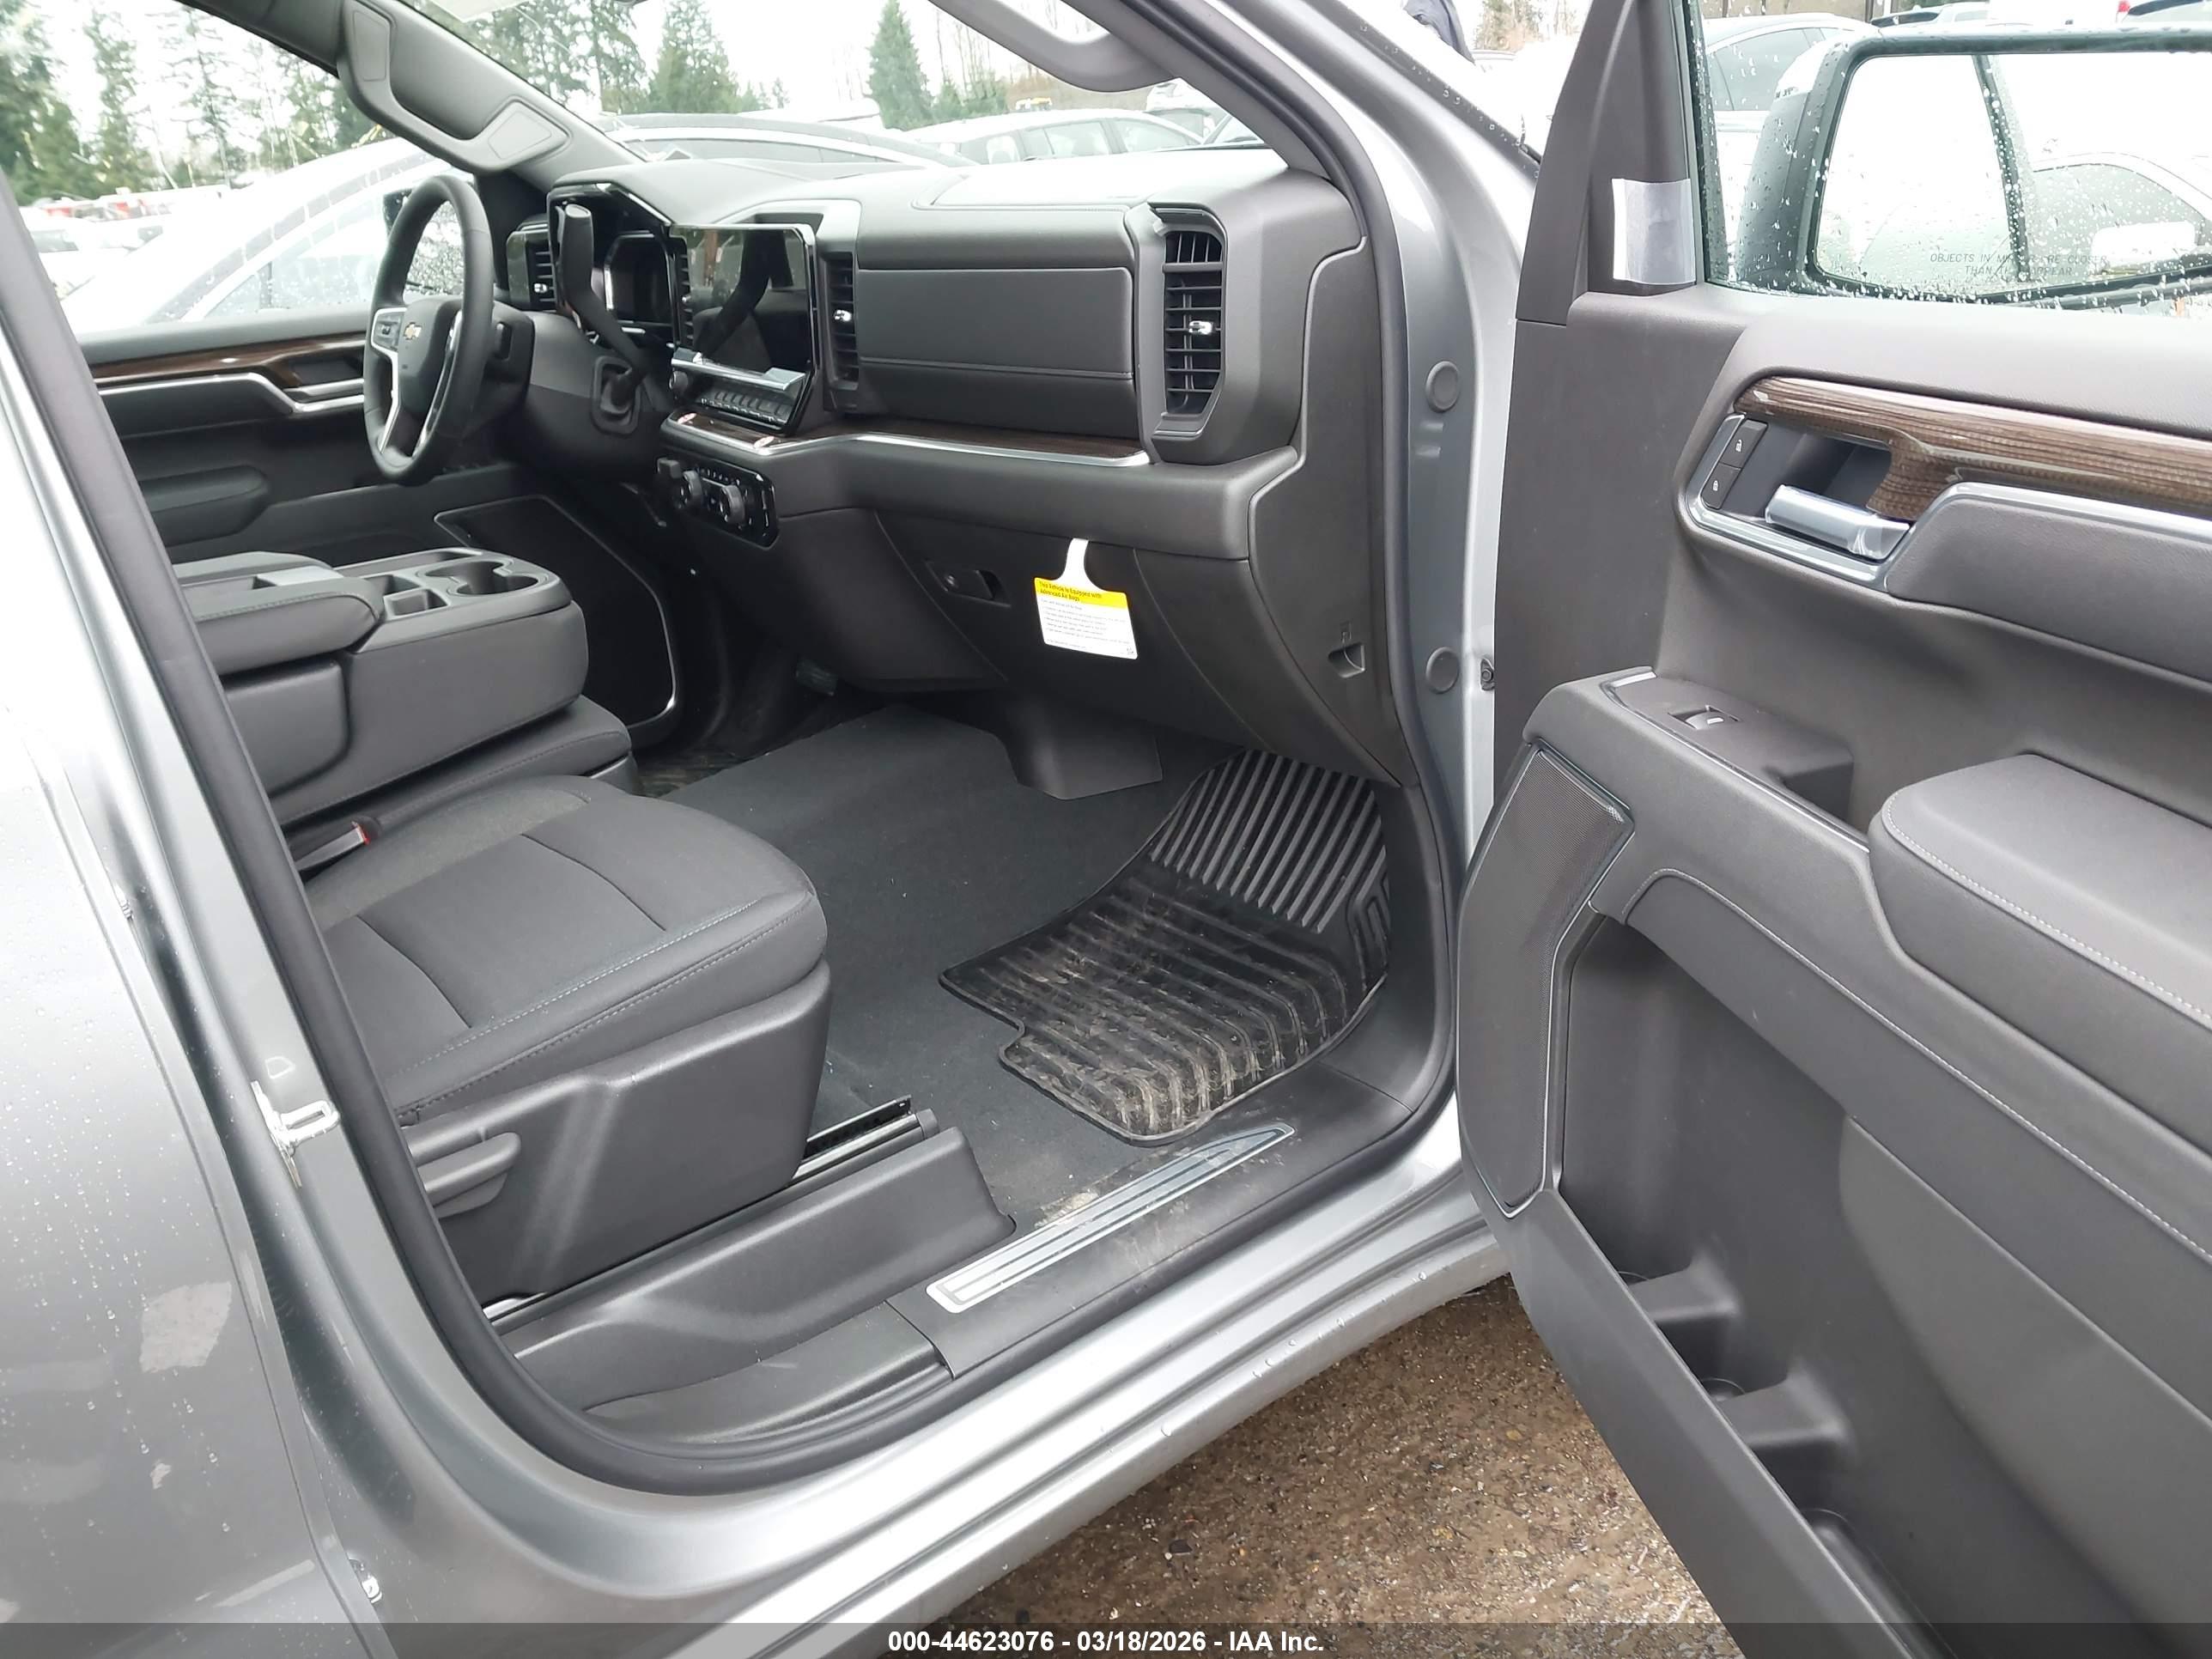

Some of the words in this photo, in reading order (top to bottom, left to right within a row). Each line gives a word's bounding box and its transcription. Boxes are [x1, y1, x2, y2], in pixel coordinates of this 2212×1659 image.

[1929, 253, 1975, 263] OBJECTS
[1980, 253, 1991, 263] IN
[1965, 265, 1992, 276] THAN
